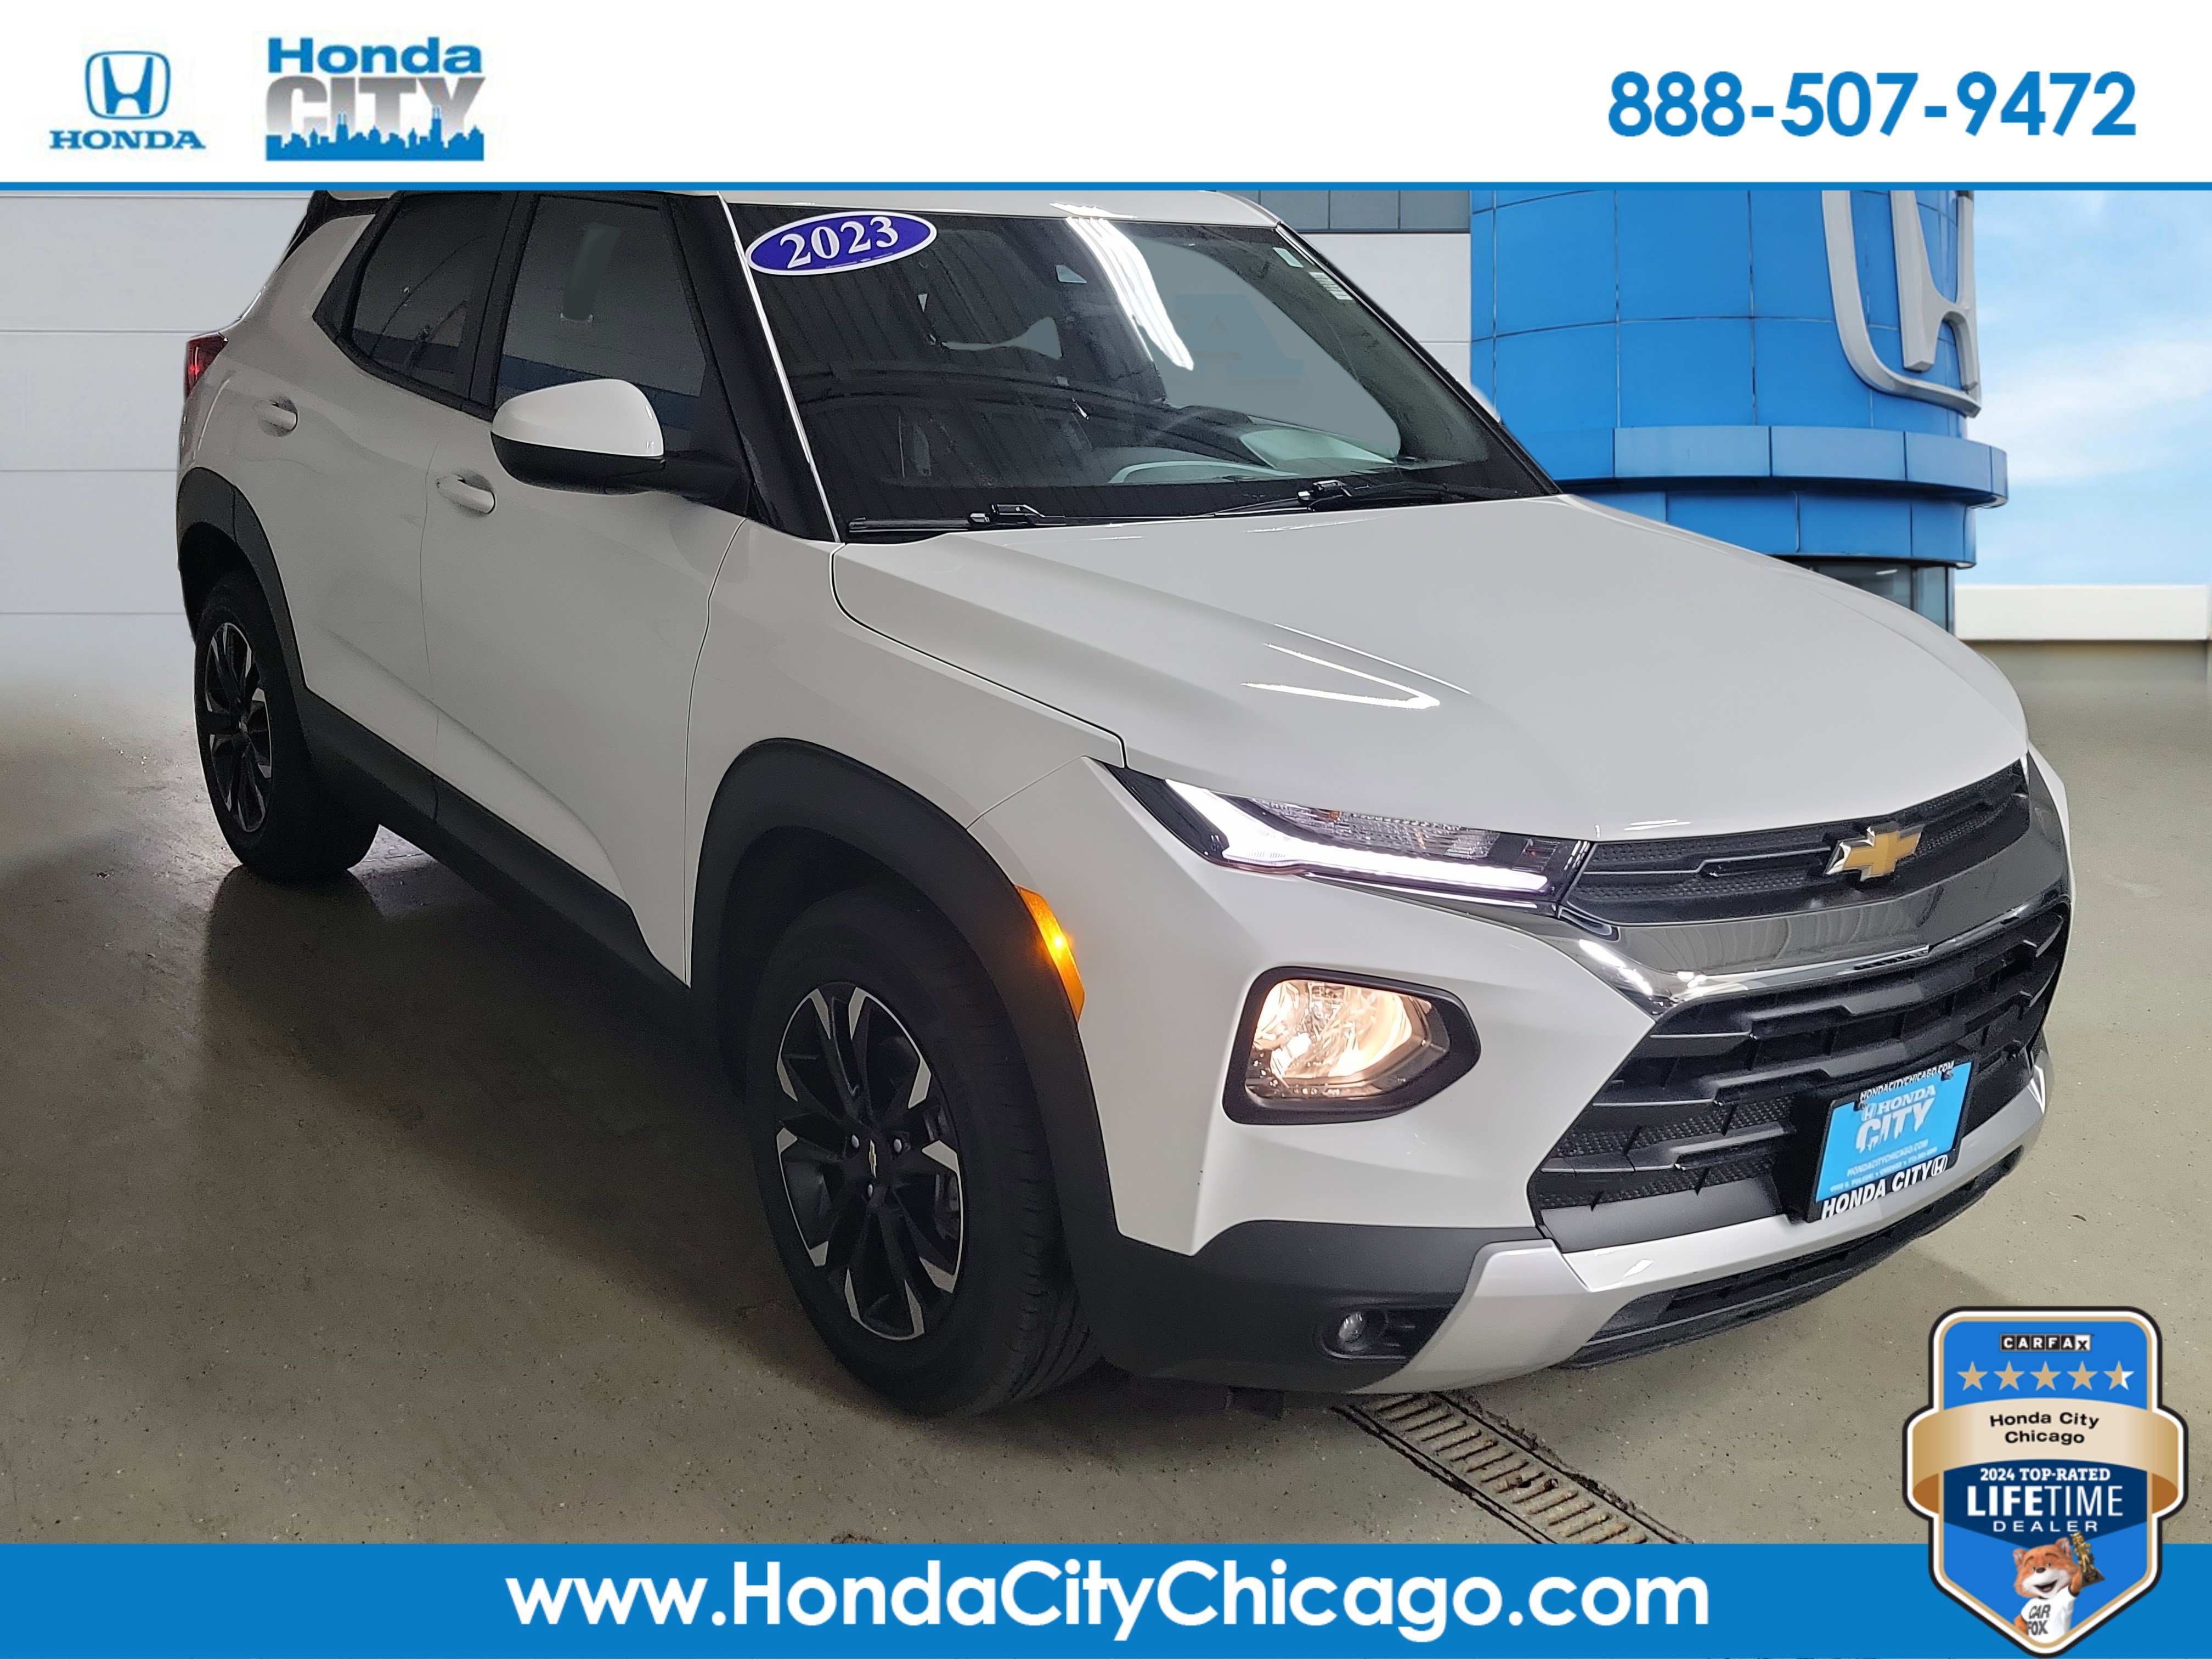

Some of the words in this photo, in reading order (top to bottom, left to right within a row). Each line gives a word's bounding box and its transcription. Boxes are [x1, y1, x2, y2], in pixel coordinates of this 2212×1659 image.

[780, 216, 899, 269] 2023
[1855, 1097, 1935, 1154] CITY
[1876, 1084, 1937, 1115] HONDA
[1821, 1178, 1886, 1220] HONDA
[1892, 1159, 1932, 1193] CITY
